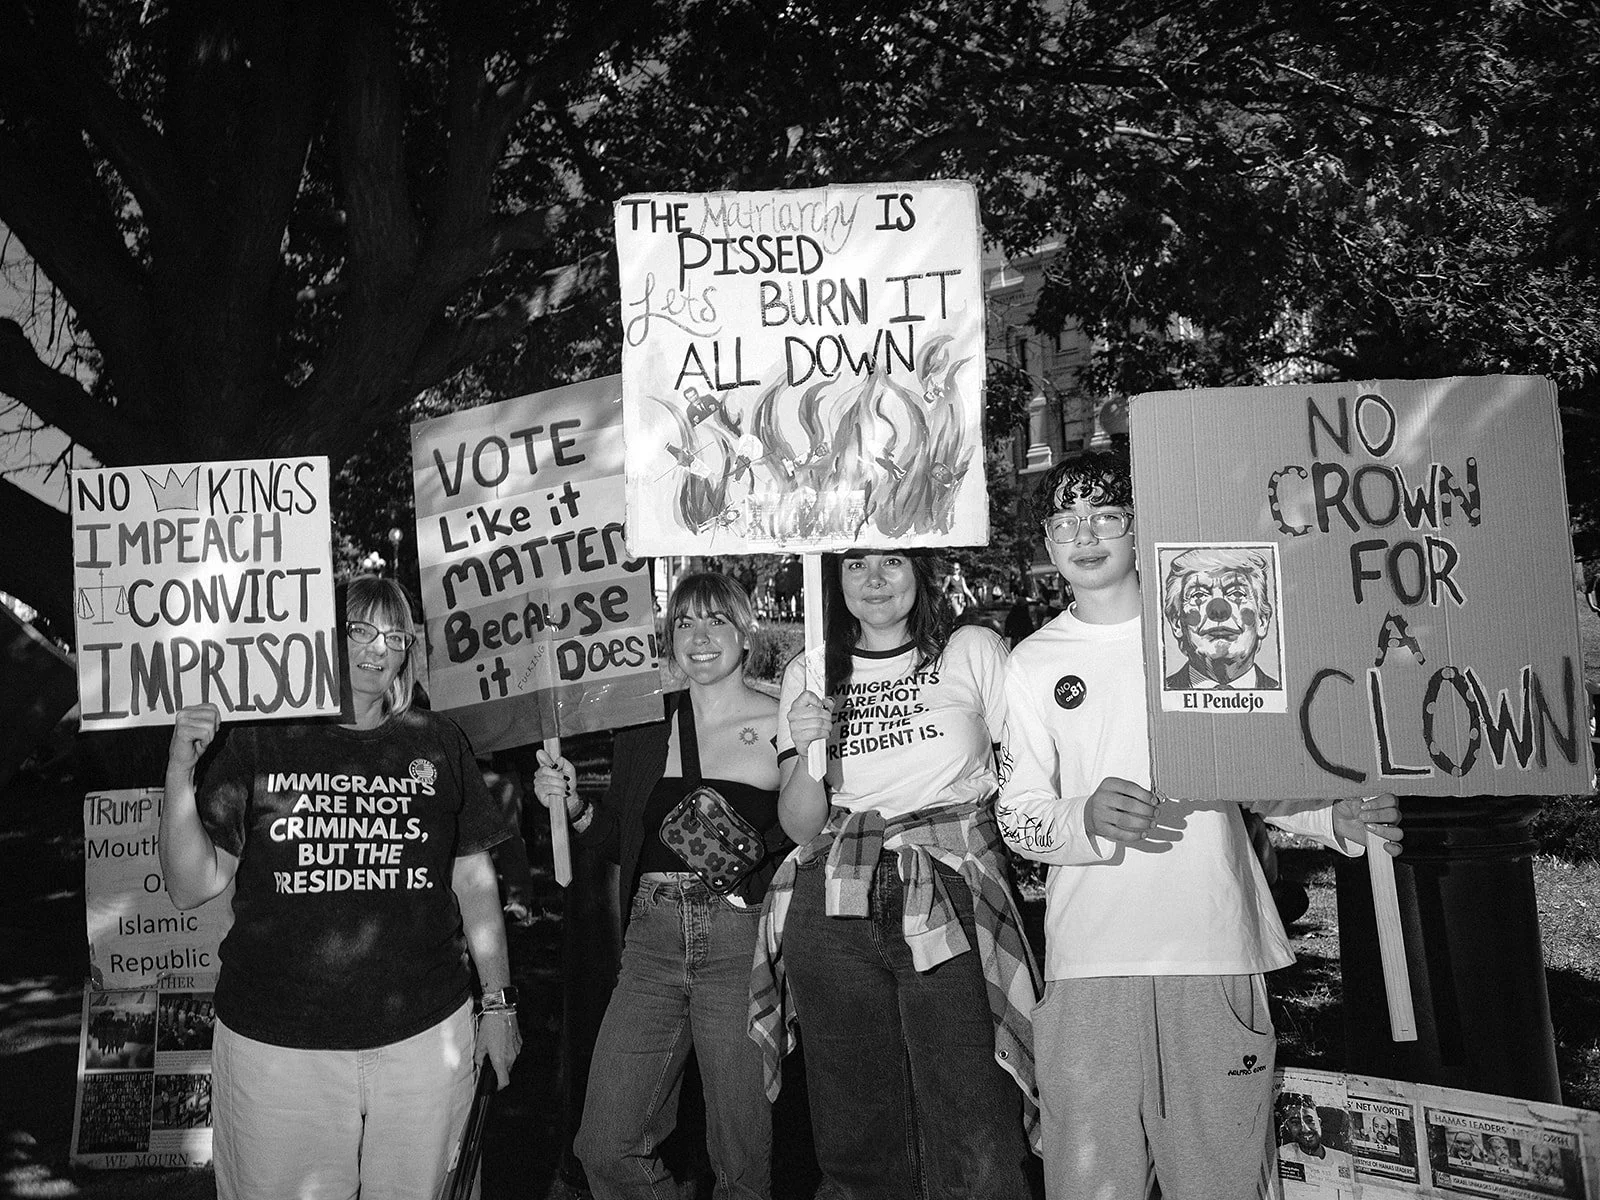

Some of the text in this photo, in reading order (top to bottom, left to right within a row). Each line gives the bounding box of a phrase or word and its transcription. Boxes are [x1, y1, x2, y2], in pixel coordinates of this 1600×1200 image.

[621, 192, 916, 255] THE Matriarchy IS
[677, 233, 824, 292] PISSED
[760, 277, 868, 327] BURN
[885, 269, 962, 323] IT
[674, 324, 915, 391] ALL DOWN
[1306, 392, 1397, 458] NO
[433, 419, 585, 497] VOTE
[77, 460, 317, 516] NO KINGS
[1267, 457, 1481, 537] CROWN
[439, 481, 580, 553] Like it
[76, 513, 282, 569] IMPEACH
[1350, 536, 1465, 606] FOR
[127, 567, 321, 628] CONVICT
[1375, 611, 1426, 667] A
[82, 627, 340, 719] IMPRISON
[476, 657, 511, 700] it
[517, 644, 545, 690] FUCKING
[831, 672, 940, 696] MMIGRANTS
[1056, 682, 1071, 697] NO
[1070, 681, 1085, 697] 81
[841, 688, 920, 709] ARE NOT
[1183, 692, 1264, 712] El Pendejo
[1299, 656, 1578, 784] CLOWN
[826, 724, 945, 760] RESIDENT IS.
[840, 718, 911, 739] BUT THE
[86, 796, 152, 825] TRUMP
[292, 794, 412, 815] ARE NOT
[269, 816, 429, 843] CRIMINALS,
[299, 843, 404, 866] BUT THE
[274, 867, 434, 894] PRESIDENT IS.
[119, 912, 198, 935] Islamic
[111, 948, 210, 976] Republic
[1356, 1102, 1371, 1112] NET
[1373, 1104, 1405, 1117] WORTH
[1434, 1114, 1467, 1128] HAMAS
[105, 1153, 188, 1168] WE MOURN
